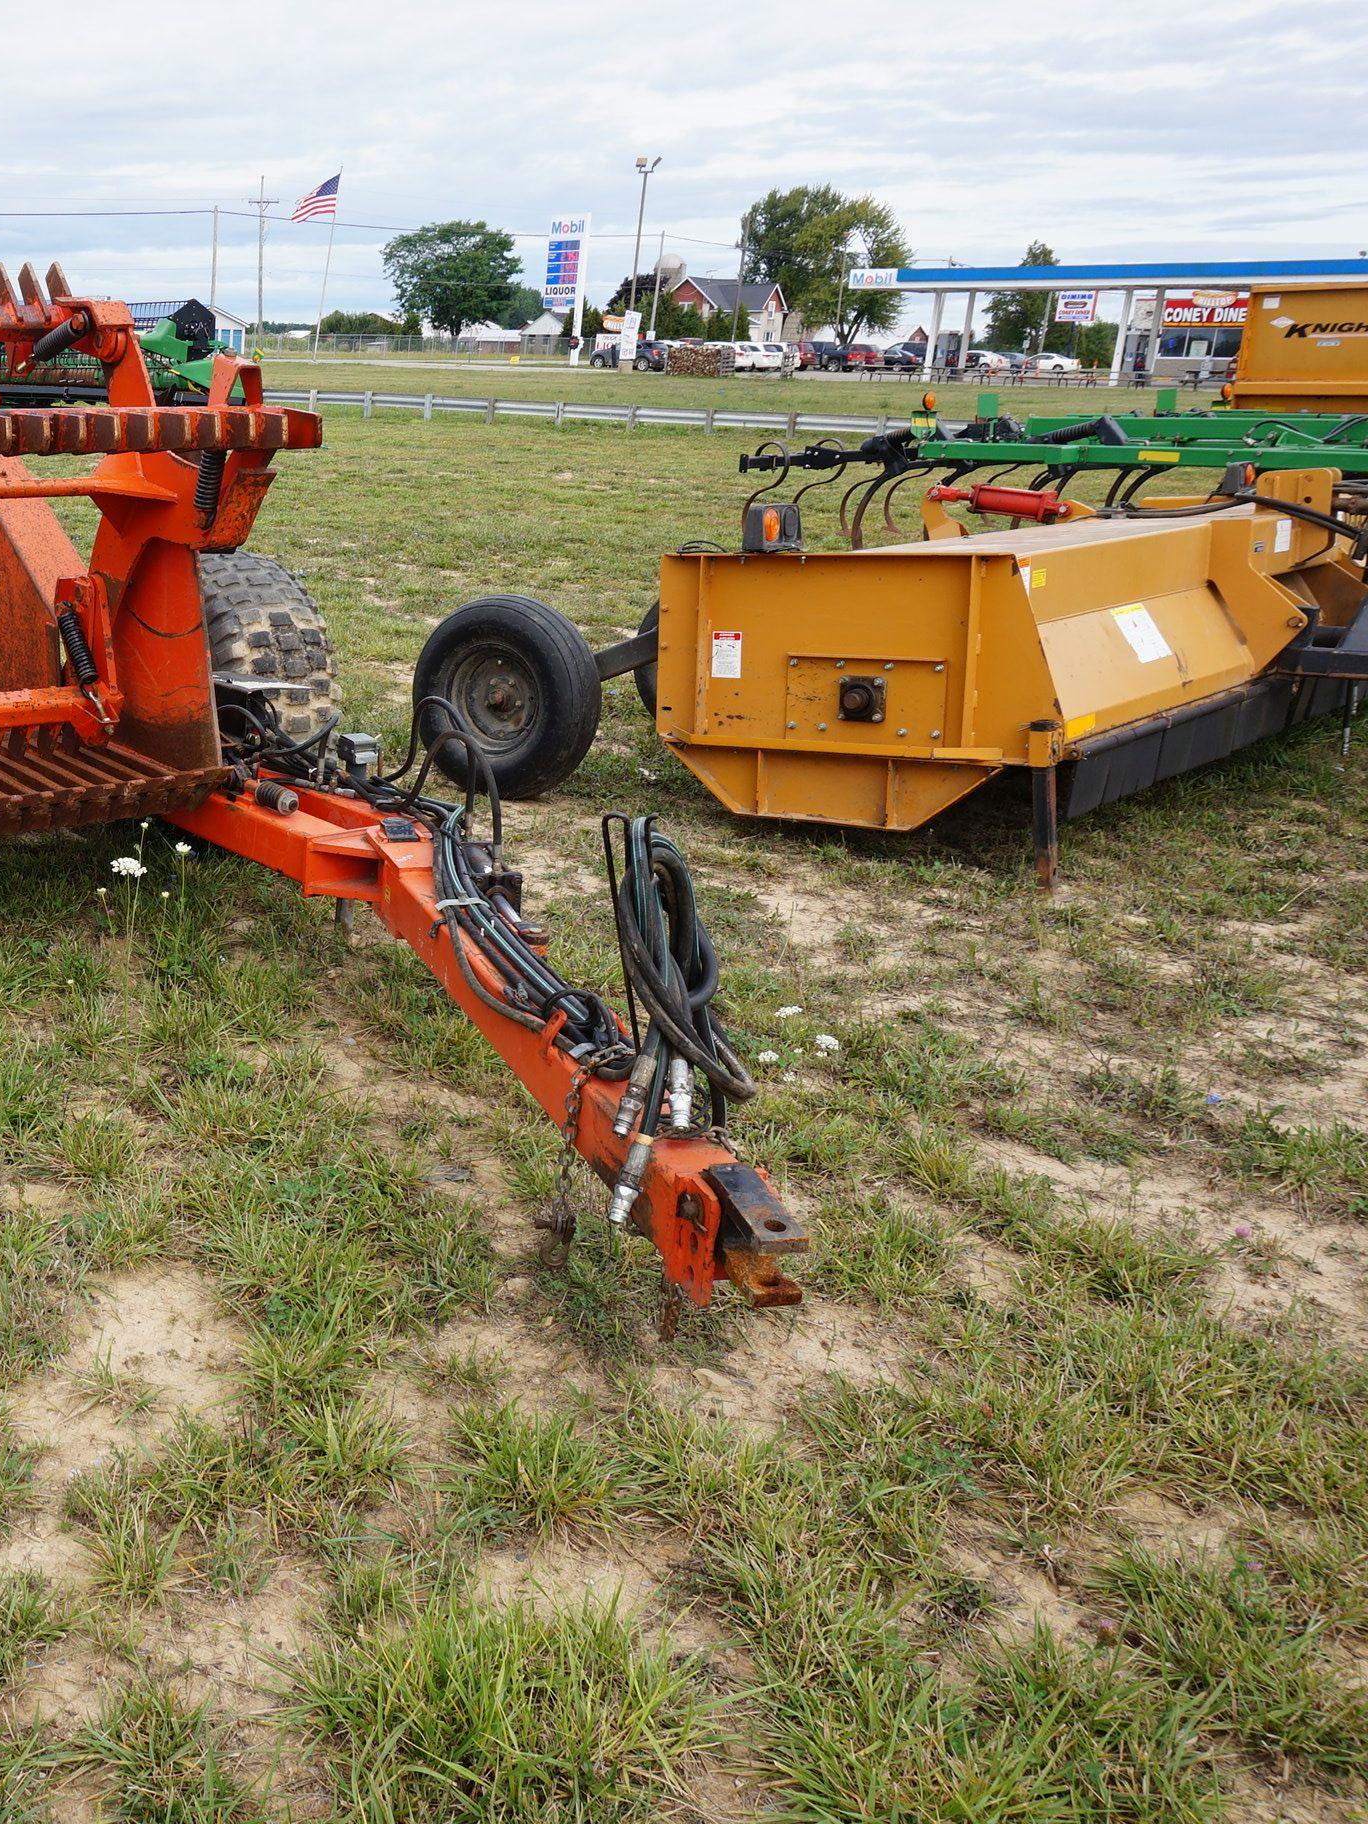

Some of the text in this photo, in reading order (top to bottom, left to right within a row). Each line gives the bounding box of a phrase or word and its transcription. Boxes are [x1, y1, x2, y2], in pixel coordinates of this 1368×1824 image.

[552, 220, 584, 234] Mobil
[853, 272, 892, 286] Mobil
[545, 287, 576, 295] LIQUOR
[1197, 295, 1232, 306] HILLTOP
[1164, 307, 1211, 322] CONEY
